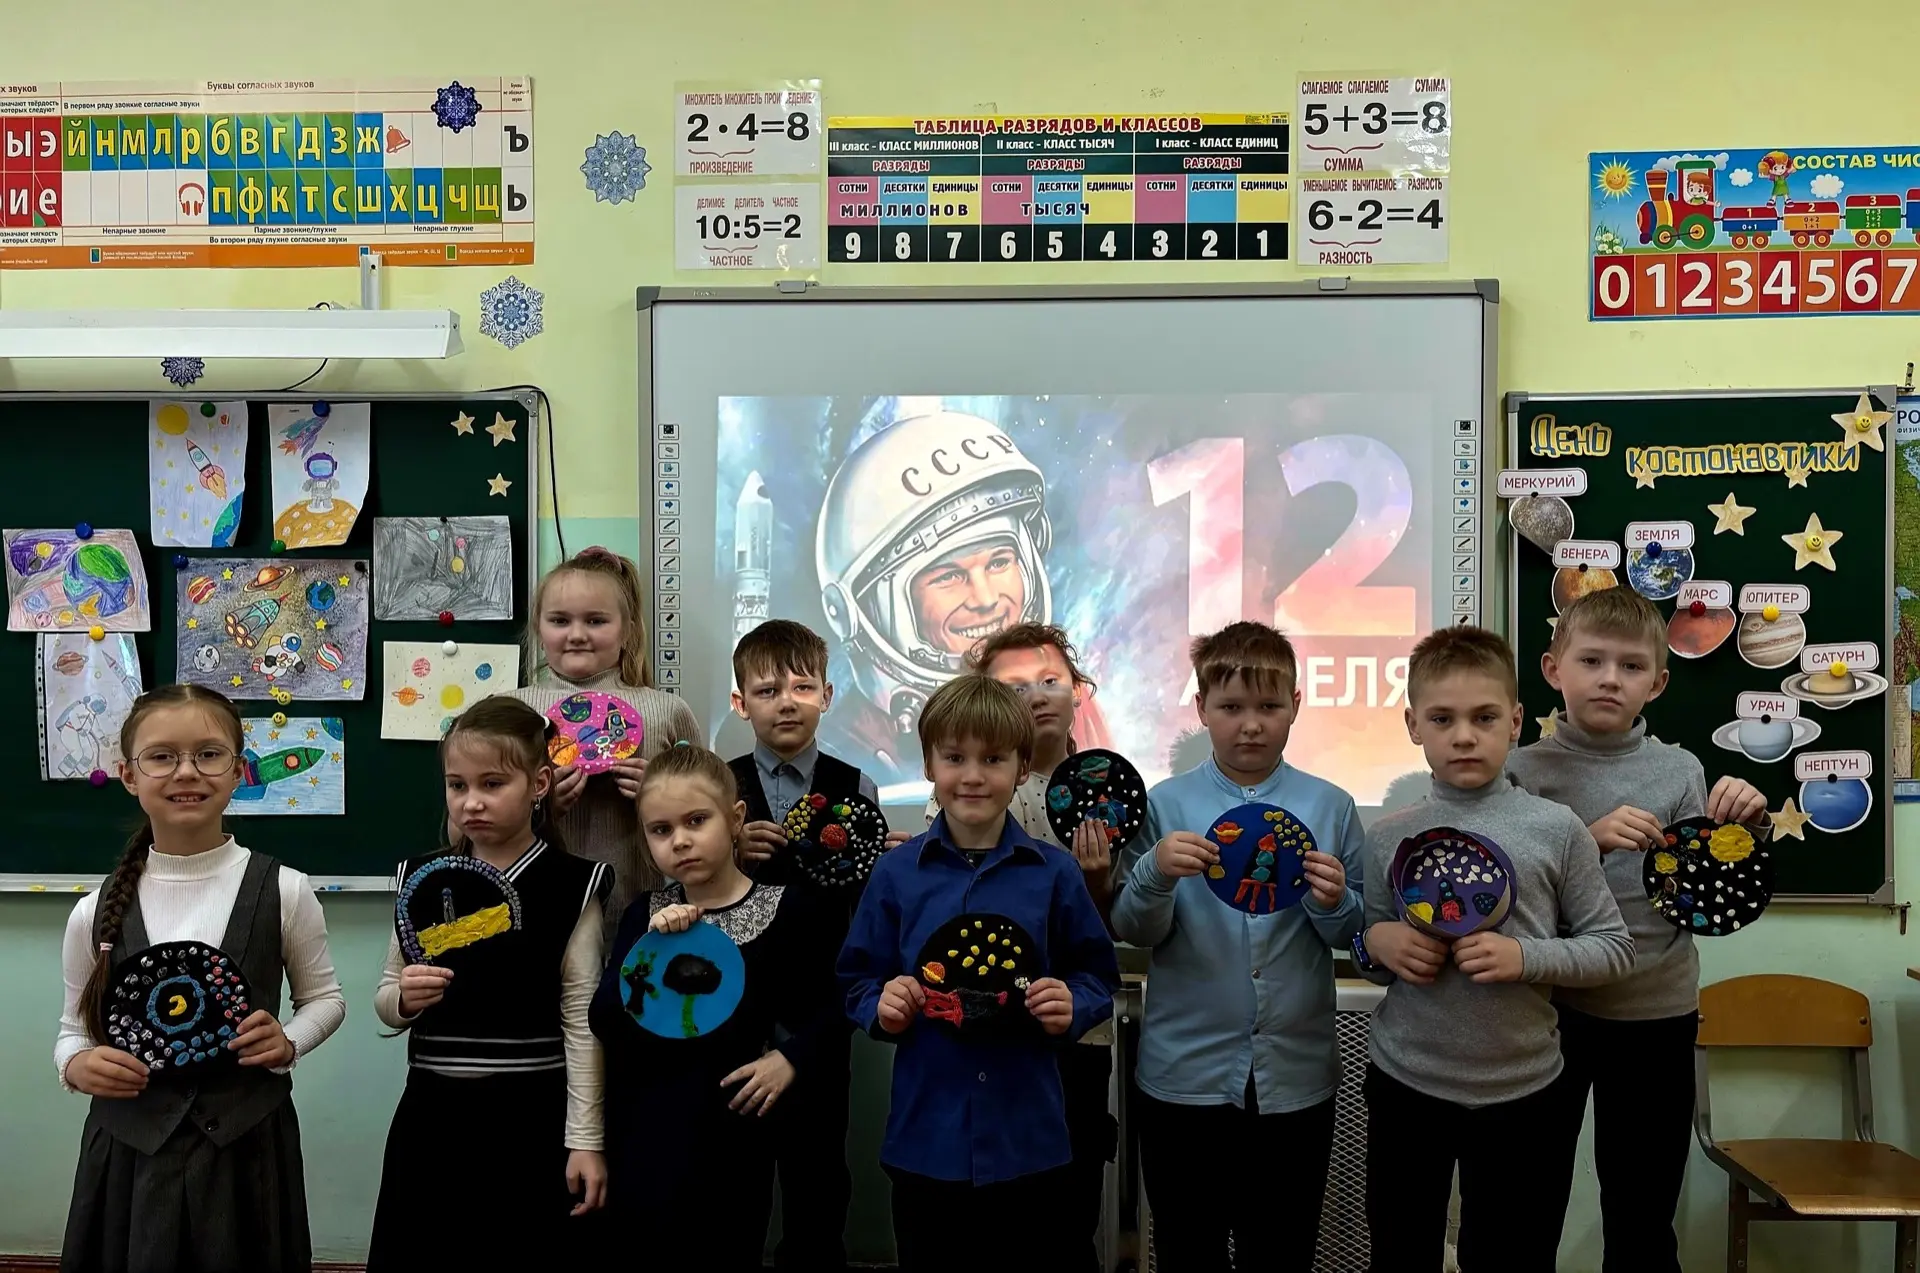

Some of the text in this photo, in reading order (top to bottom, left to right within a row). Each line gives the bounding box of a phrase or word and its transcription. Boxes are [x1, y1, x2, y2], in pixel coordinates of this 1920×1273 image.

[8, 86, 37, 94] звуков
[207, 81, 315, 92] Буквы согласных звуков
[1302, 79, 1446, 94] СЛАГАЕМОЕ СЛАГАЕМОЕ СУММА
[684, 93, 723, 106] МНОЖИТЕЛЬ
[725, 93, 762, 105] МНОЖИТЕЛЬ
[914, 117, 1202, 136] ТАБЛИЦА РАЗРЯДОВ И КЛАССОВ
[841, 142, 869, 151] класс
[879, 141, 911, 151] КЛАСС
[914, 140, 979, 150] МИЛЛИОНОВ
[1006, 140, 1034, 150] класс
[1043, 139, 1077, 149] КЛАСС
[1078, 139, 1115, 149] ТЫСЯЧ
[1162, 139, 1190, 149] класс
[1200, 138, 1233, 148] КЛАСС
[1235, 137, 1279, 150] ЕДИНИЦ
[690, 161, 753, 175] ПРОИЗВЕДЕНИЕ
[873, 160, 930, 173] РАЗРЯДЫ
[1027, 159, 1085, 172] РАЗРЯДЫ
[1183, 157, 1241, 170] РАЗРЯДЫ
[1324, 158, 1363, 172] СУММА
[1793, 154, 1877, 169] СОСТАВ
[838, 182, 868, 193] СОТНИ
[884, 183, 926, 194] ДЕСЯТКИ
[932, 182, 979, 193] ЕДИНИЦЫ
[992, 182, 1022, 193] СОТНИ
[1038, 182, 1080, 193] ДЕСЯТКИ
[1087, 181, 1133, 192] ЕДИНИЦЫ
[1146, 181, 1177, 191] СОТНИ
[1192, 180, 1235, 192] ДЕСЯТКИ
[1241, 180, 1288, 192] ЕДИНИЦЫ
[1304, 178, 1443, 192] УМЕНЬШАЕМОЕ ВЫЧИТАЕМОЕ РАЗНОСТЬ
[697, 197, 799, 210] ДЕЛИМОЕ ДЕЛИТЕЛЬ ЧАСТНОЕ
[1870, 196, 1877, 205] 3
[1746, 208, 1752, 218] 1
[1808, 203, 1816, 213] 2
[413, 225, 474, 233] Непарные глухие
[209, 236, 219, 244] Во
[327, 236, 348, 244] звуки
[845, 230, 1268, 260] 9 8 7 6 5 4 3 2 1
[709, 256, 753, 266] ЧАСТНОЕ
[1319, 252, 1373, 265] РАЗНОСТЬ
[1599, 257, 1918, 309] 0 1 2 3 4 5 6 7
[1532, 414, 1610, 457] День
[901, 434, 1014, 496] СССР
[1504, 474, 1576, 489] МЕРКУРИЙ
[1146, 434, 1416, 636] 12
[1635, 528, 1680, 541] ЗЕМЛЯ
[1560, 548, 1610, 561] ВЕНЕРА
[1684, 589, 1718, 600] МАРС
[1746, 592, 1799, 604] ЮПИТЕР
[1812, 650, 1865, 664] САТУРН
[1750, 700, 1785, 712] УРАН
[1804, 758, 1859, 772] НЕПТУН
